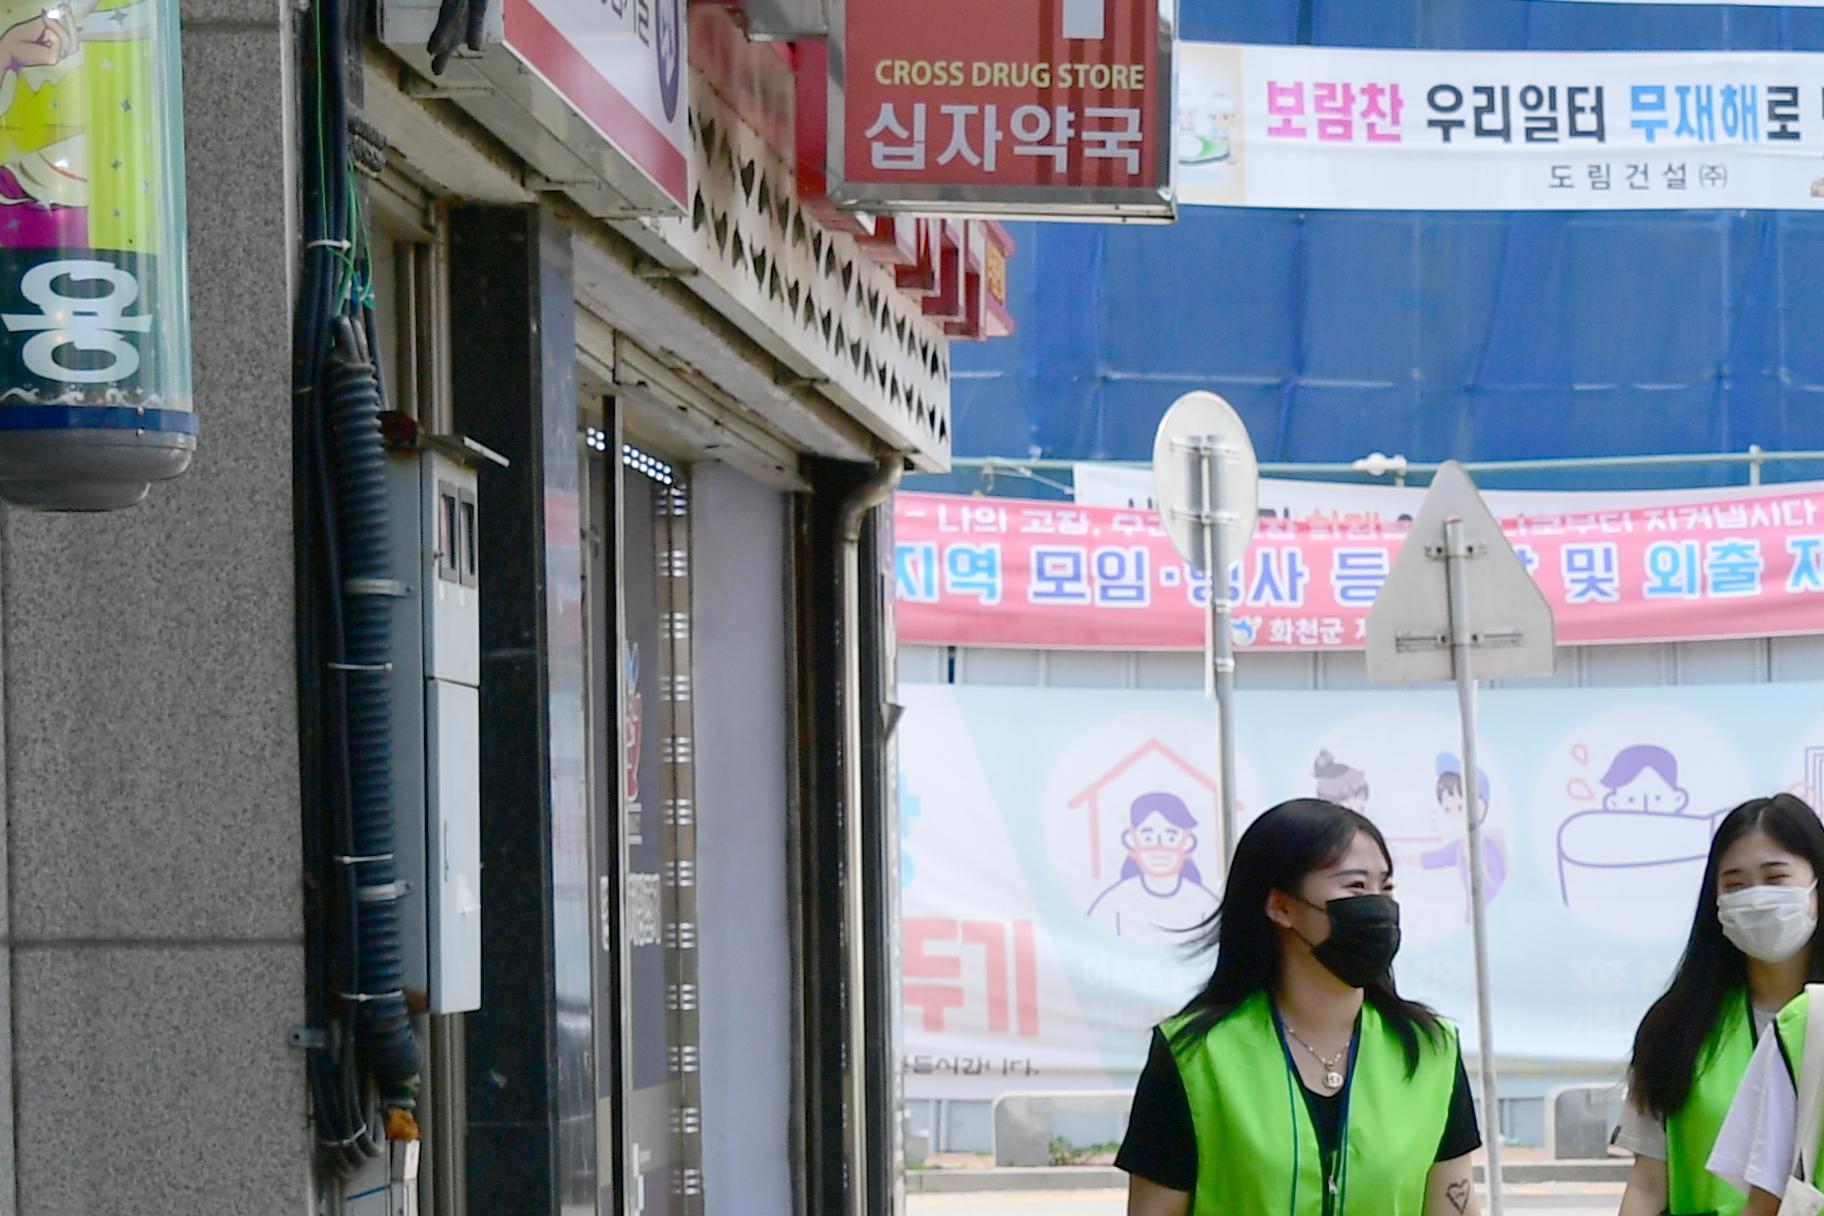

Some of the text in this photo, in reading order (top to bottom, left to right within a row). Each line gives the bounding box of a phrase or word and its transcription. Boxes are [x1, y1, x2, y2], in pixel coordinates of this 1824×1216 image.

[874, 59, 1146, 92] CROSS DRUG STORE
[1266, 78, 1405, 144] 보람찬
[1425, 82, 1607, 145] 우리일터
[1629, 82, 1804, 146] 무재해로
[864, 100, 1145, 176] 십자약국
[937, 505, 1008, 534] 나의
[1644, 500, 1816, 534] 지켜냅시다
[895, 543, 1000, 603] 지역
[1564, 544, 1617, 601] 및
[1646, 537, 1761, 596] 외출
[1269, 615, 1345, 645] 화천군
